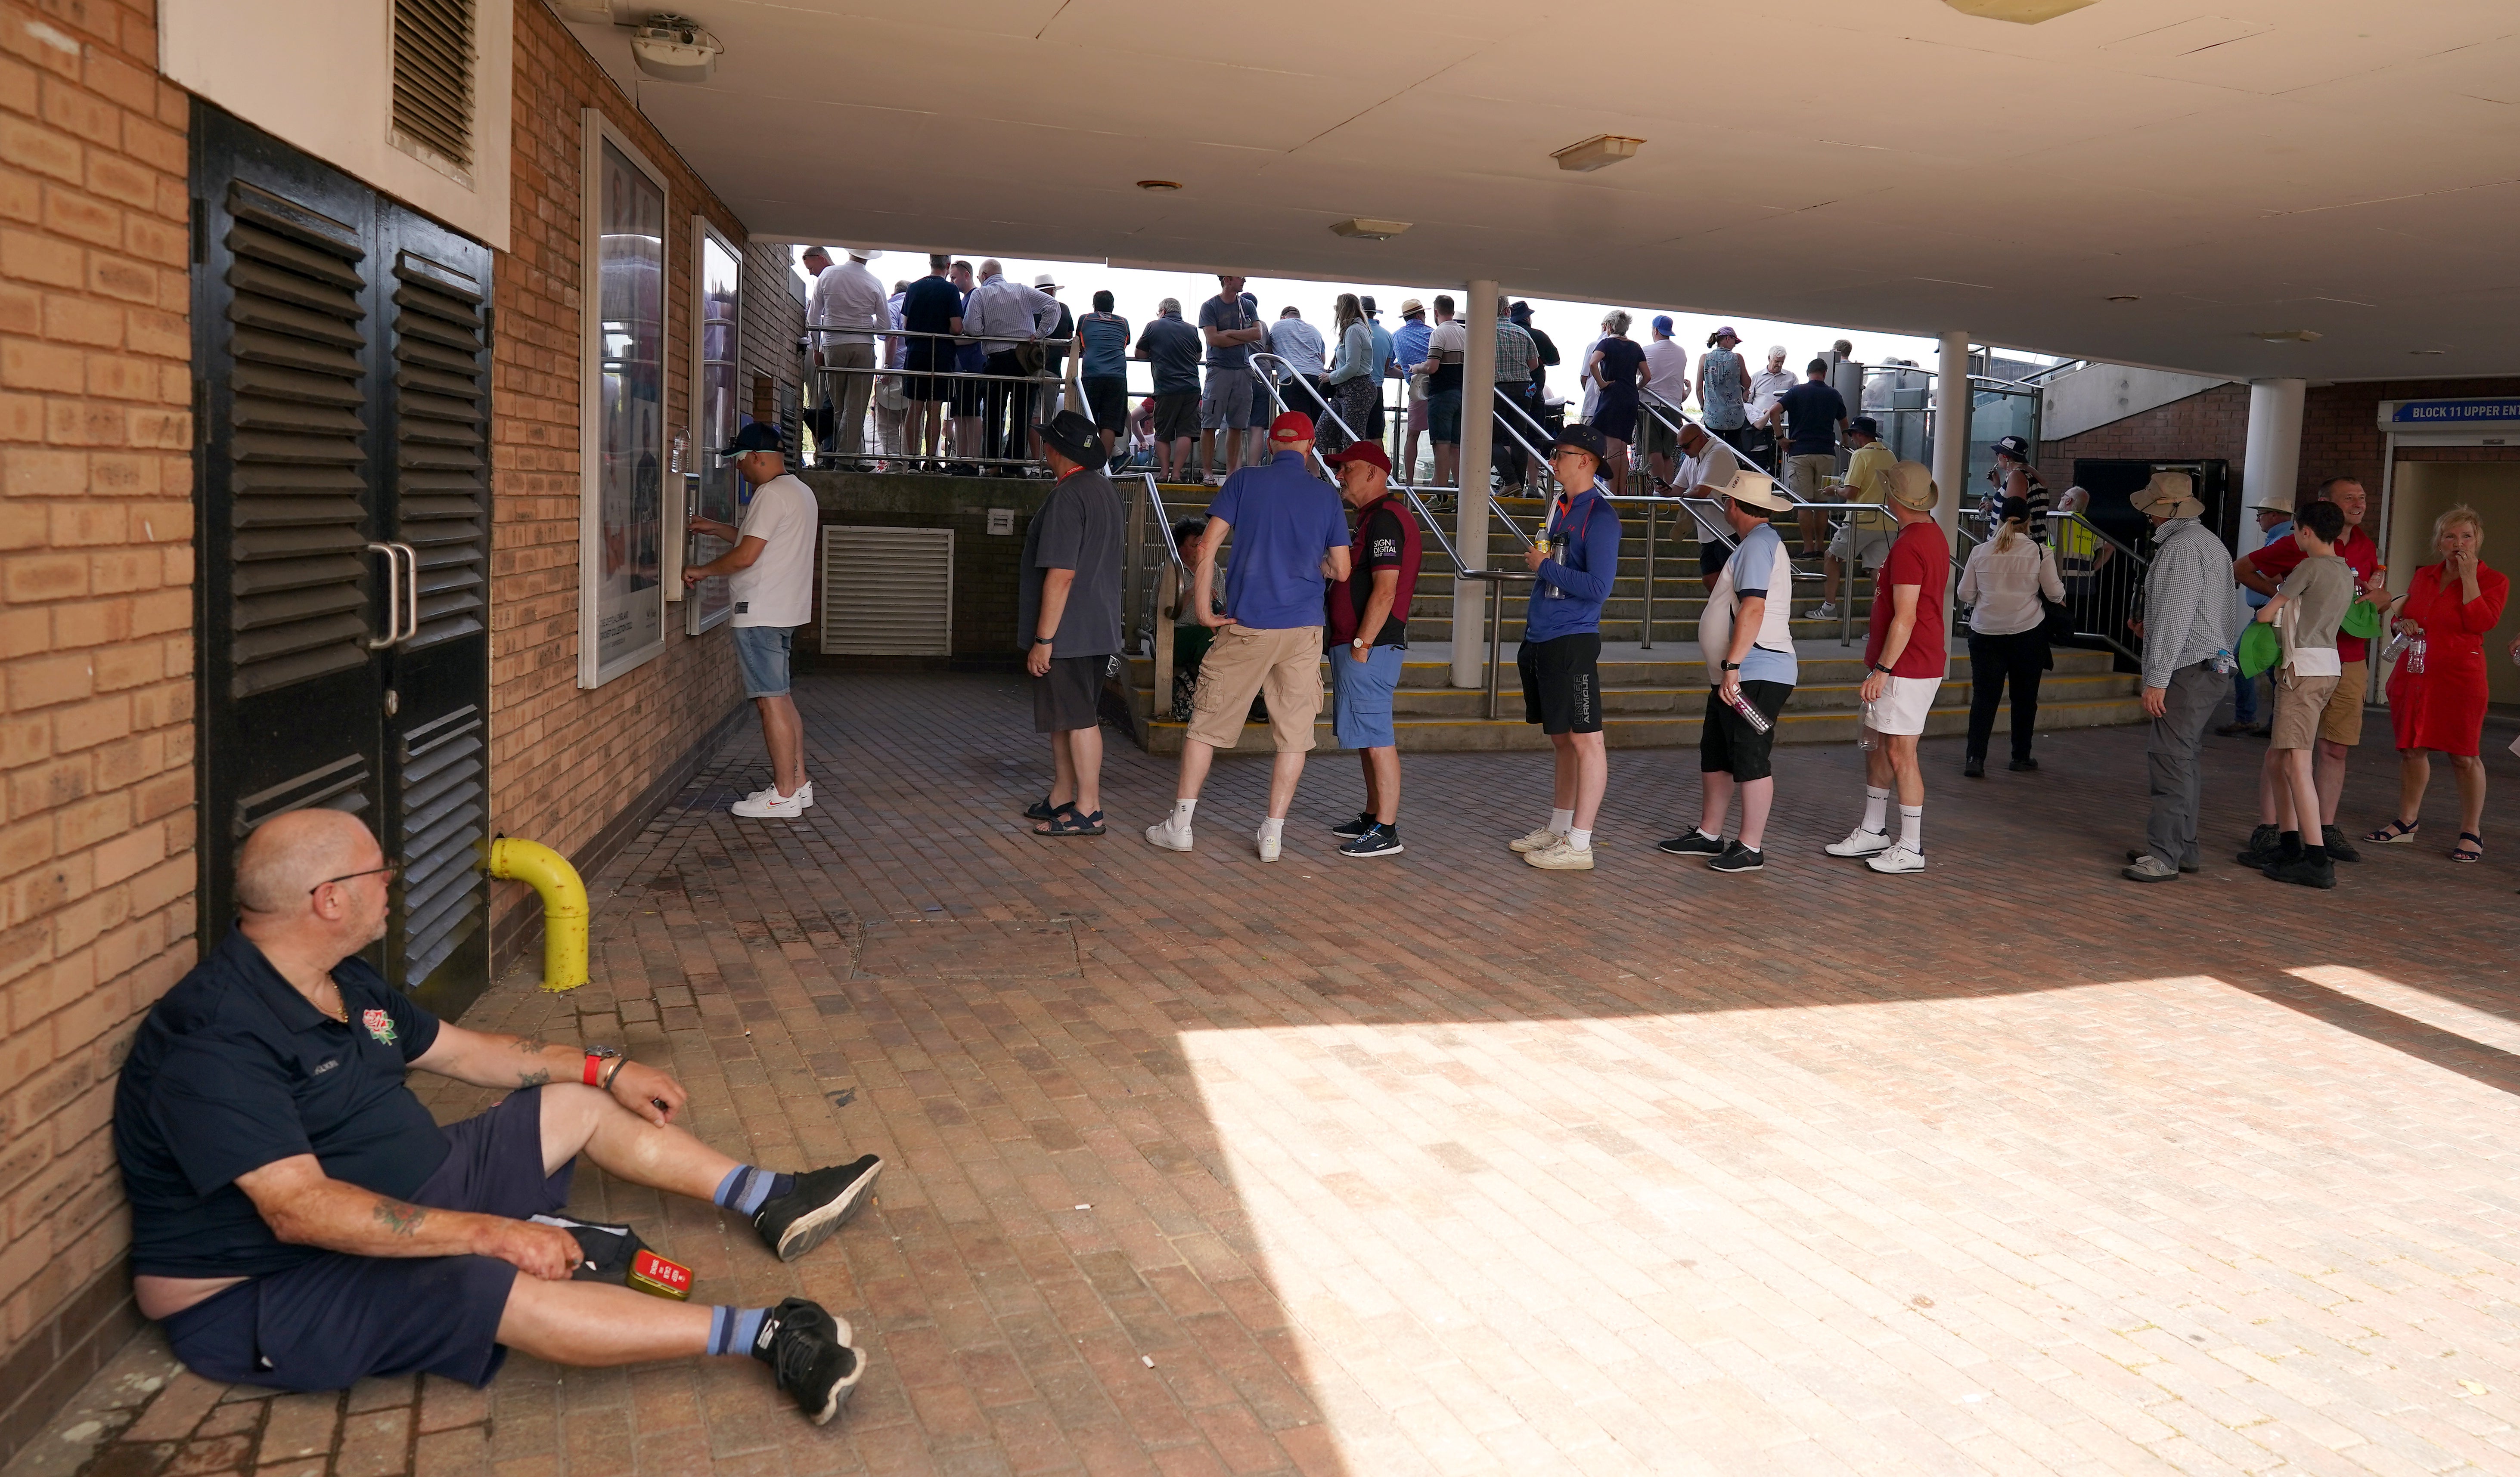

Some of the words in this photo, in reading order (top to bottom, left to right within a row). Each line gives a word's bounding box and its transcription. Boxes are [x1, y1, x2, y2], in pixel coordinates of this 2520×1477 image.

[2413, 407, 2446, 418] BLOCK
[2450, 407, 2461, 417] 11
[2464, 406, 2500, 417] UPPER
[1374, 539, 1391, 547] SIGN
[1573, 674, 1583, 724] UNDER
[649, 1259, 660, 1276] SMOKE
[663, 1266, 672, 1279] CALM
